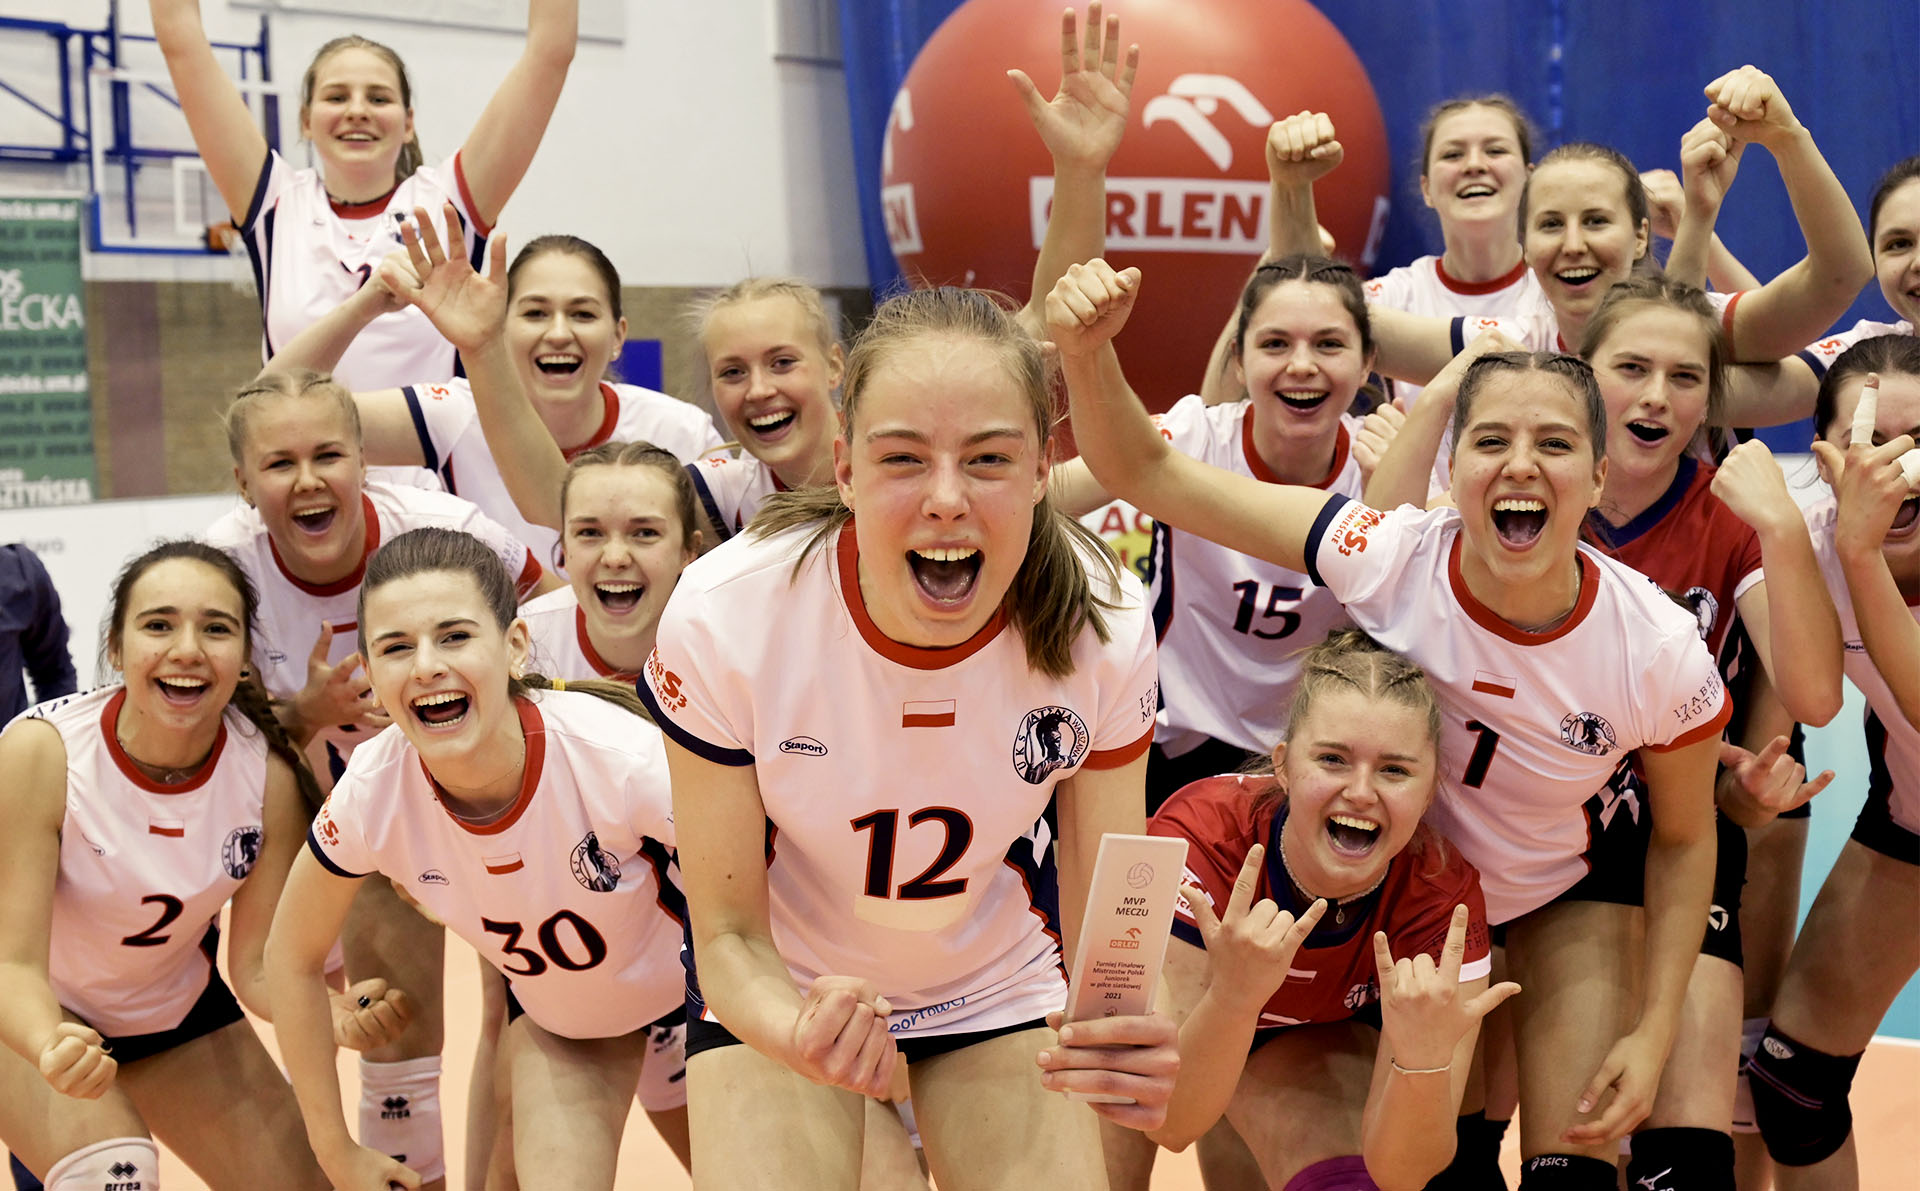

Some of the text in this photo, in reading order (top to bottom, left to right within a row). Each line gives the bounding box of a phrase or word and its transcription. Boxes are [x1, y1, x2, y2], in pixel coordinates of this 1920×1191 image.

[1045, 192, 1262, 240] RLEN
[0, 294, 84, 330] ECKA
[1232, 579, 1304, 640] 15
[784, 741, 823, 754] Staport
[1015, 735, 1027, 771] UKS
[1461, 719, 1501, 790] 1
[850, 806, 974, 900] 12
[1115, 907, 1149, 917] MECZU
[1123, 897, 1146, 905] MVP
[121, 894, 184, 947] 2
[481, 908, 607, 977] 30
[1111, 940, 1139, 949] ORLEN
[1096, 961, 1117, 969] Turniej
